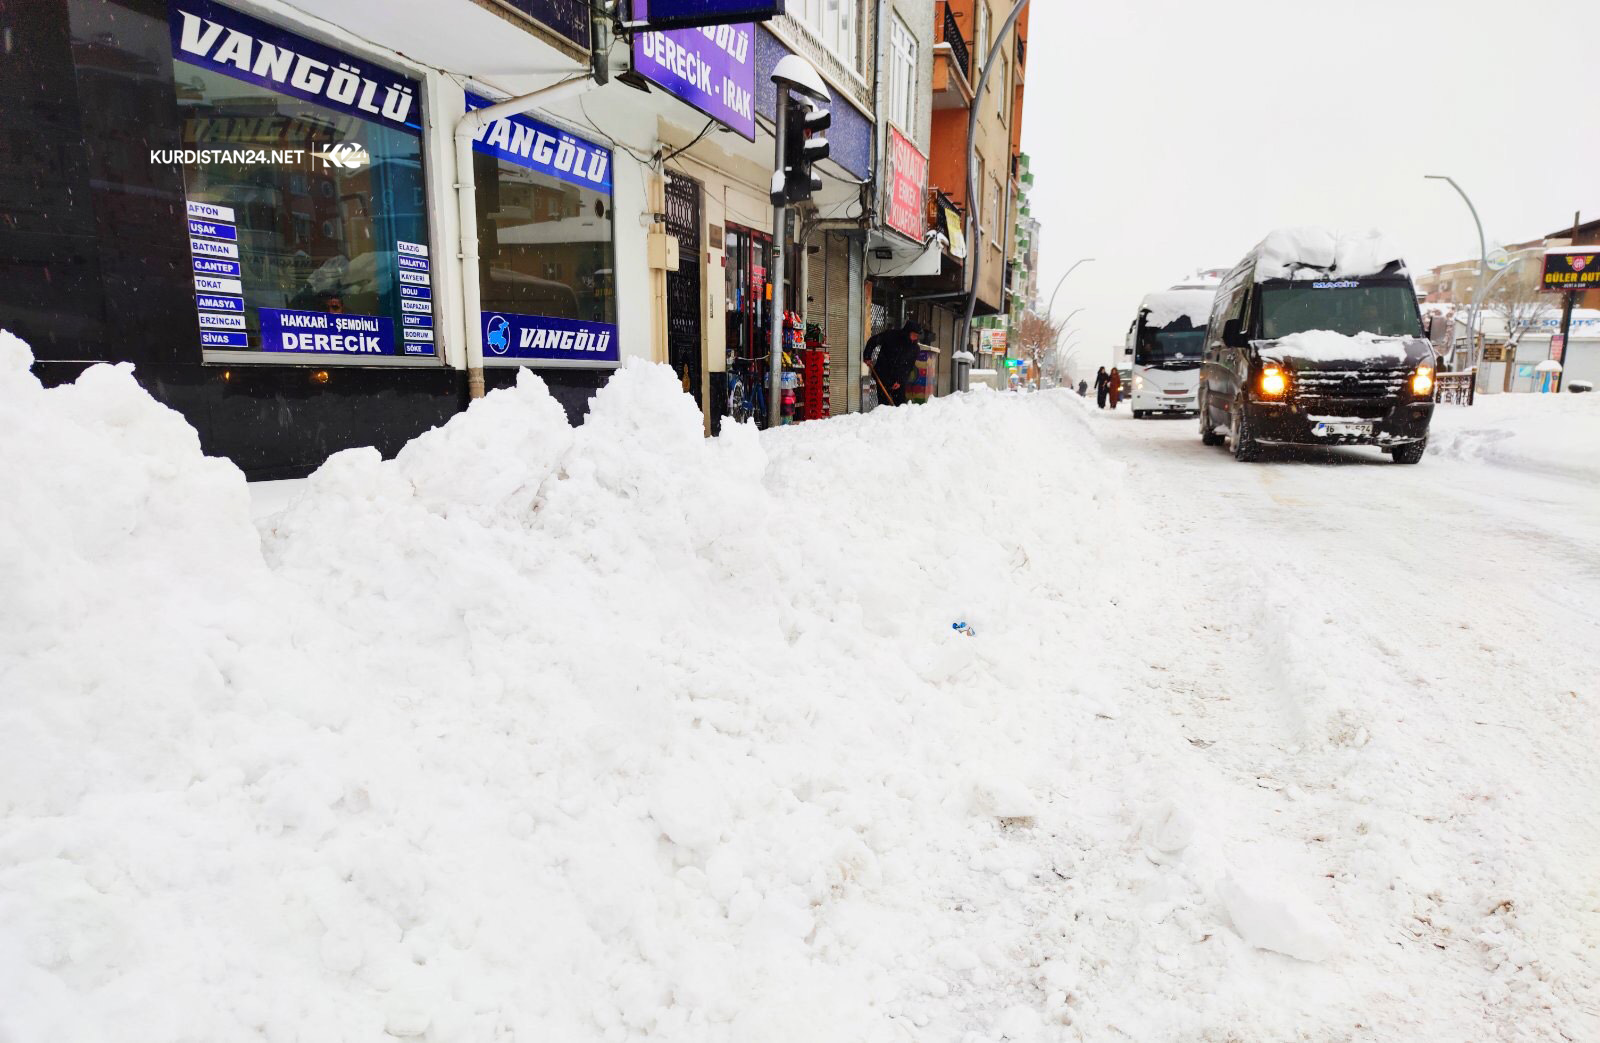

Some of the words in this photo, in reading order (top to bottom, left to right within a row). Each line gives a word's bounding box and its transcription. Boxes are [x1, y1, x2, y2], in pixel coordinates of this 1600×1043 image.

[177, 9, 413, 123] VANGÖLÜ
[642, 31, 713, 96] DERECİK
[723, 76, 752, 120] IRAK
[188, 204, 219, 216] AFYON
[190, 223, 217, 236] UŞAK
[192, 242, 230, 254] BATMAN
[194, 261, 234, 273] G.ANTEP
[400, 258, 427, 269] MALATYA
[1545, 271, 1578, 283] GÜLER
[196, 279, 222, 289] TOKAT
[402, 287, 418, 296] BOLU
[199, 298, 236, 309] AMASYA
[200, 315, 241, 326] ERZİNCAN
[280, 313, 328, 329] HAKKARİ
[336, 317, 379, 332] ŞEMDİNLİ
[202, 332, 230, 344] SİVAS
[405, 331, 429, 339] BODRUM
[519, 328, 611, 352] VANGÖLÜ
[281, 332, 382, 353] DERECİK
